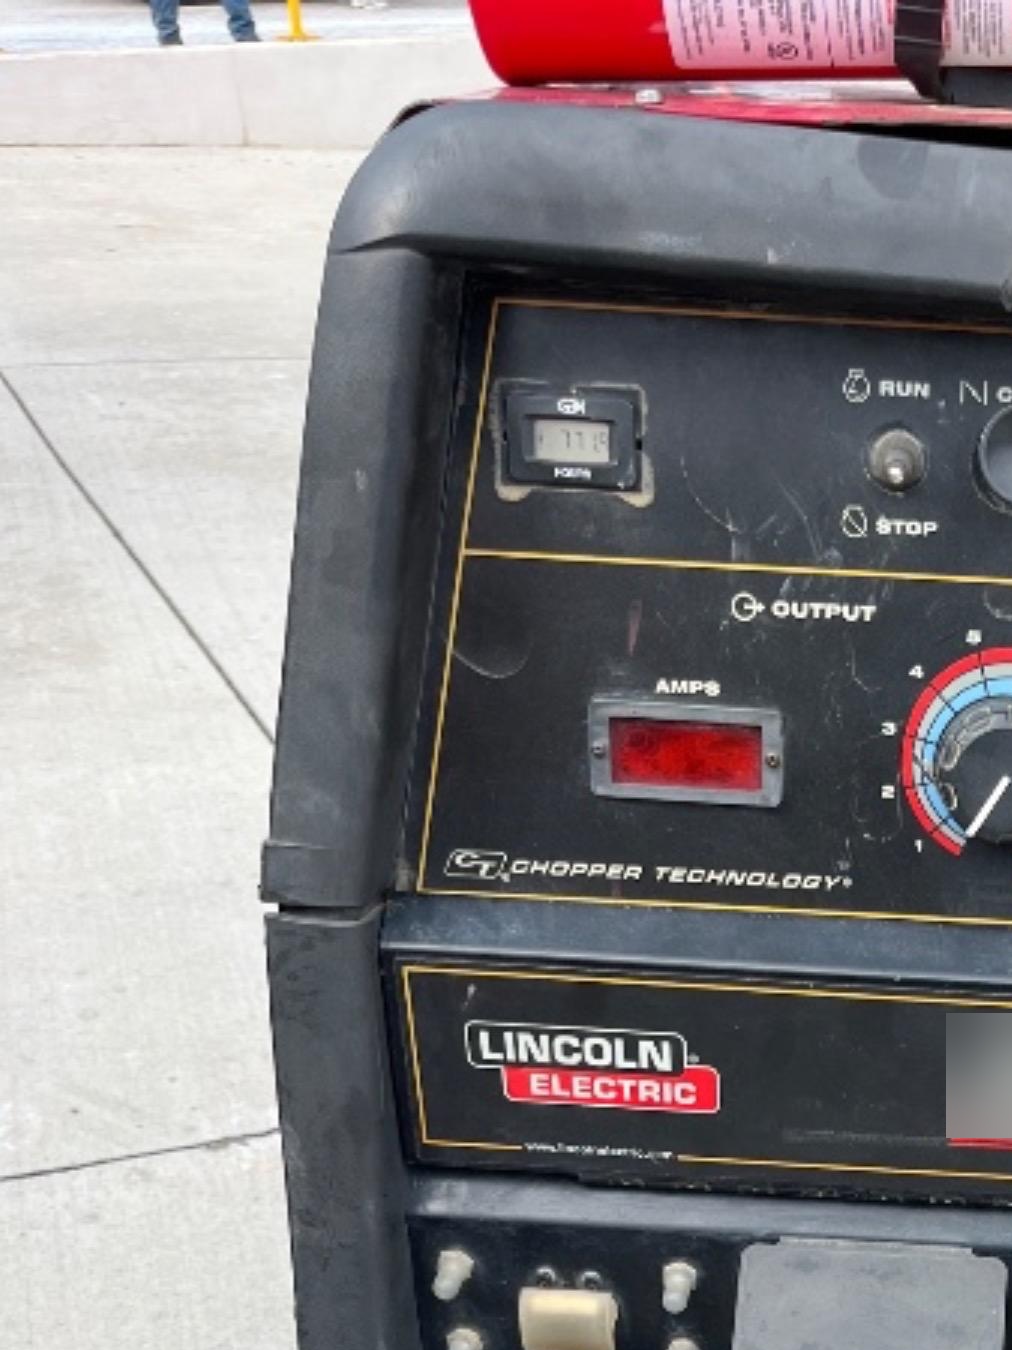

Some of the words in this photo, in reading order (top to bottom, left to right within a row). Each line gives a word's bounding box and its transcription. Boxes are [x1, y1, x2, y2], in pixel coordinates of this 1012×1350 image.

[878, 379, 930, 398] RUN
[875, 515, 938, 537] STOP
[771, 600, 877, 622] OUTPUT
[965, 629, 982, 645] 5
[908, 664, 925, 679] 4
[655, 678, 721, 697] AMPS
[881, 722, 897, 736] 3
[881, 785, 895, 799] 2
[914, 839, 922, 853] 1
[511, 859, 643, 882] CHOPPER
[655, 866, 843, 890] TECHNOLOGY
[478, 1030, 673, 1072] LINCOLN
[529, 1072, 698, 1106] ELECTRIC
